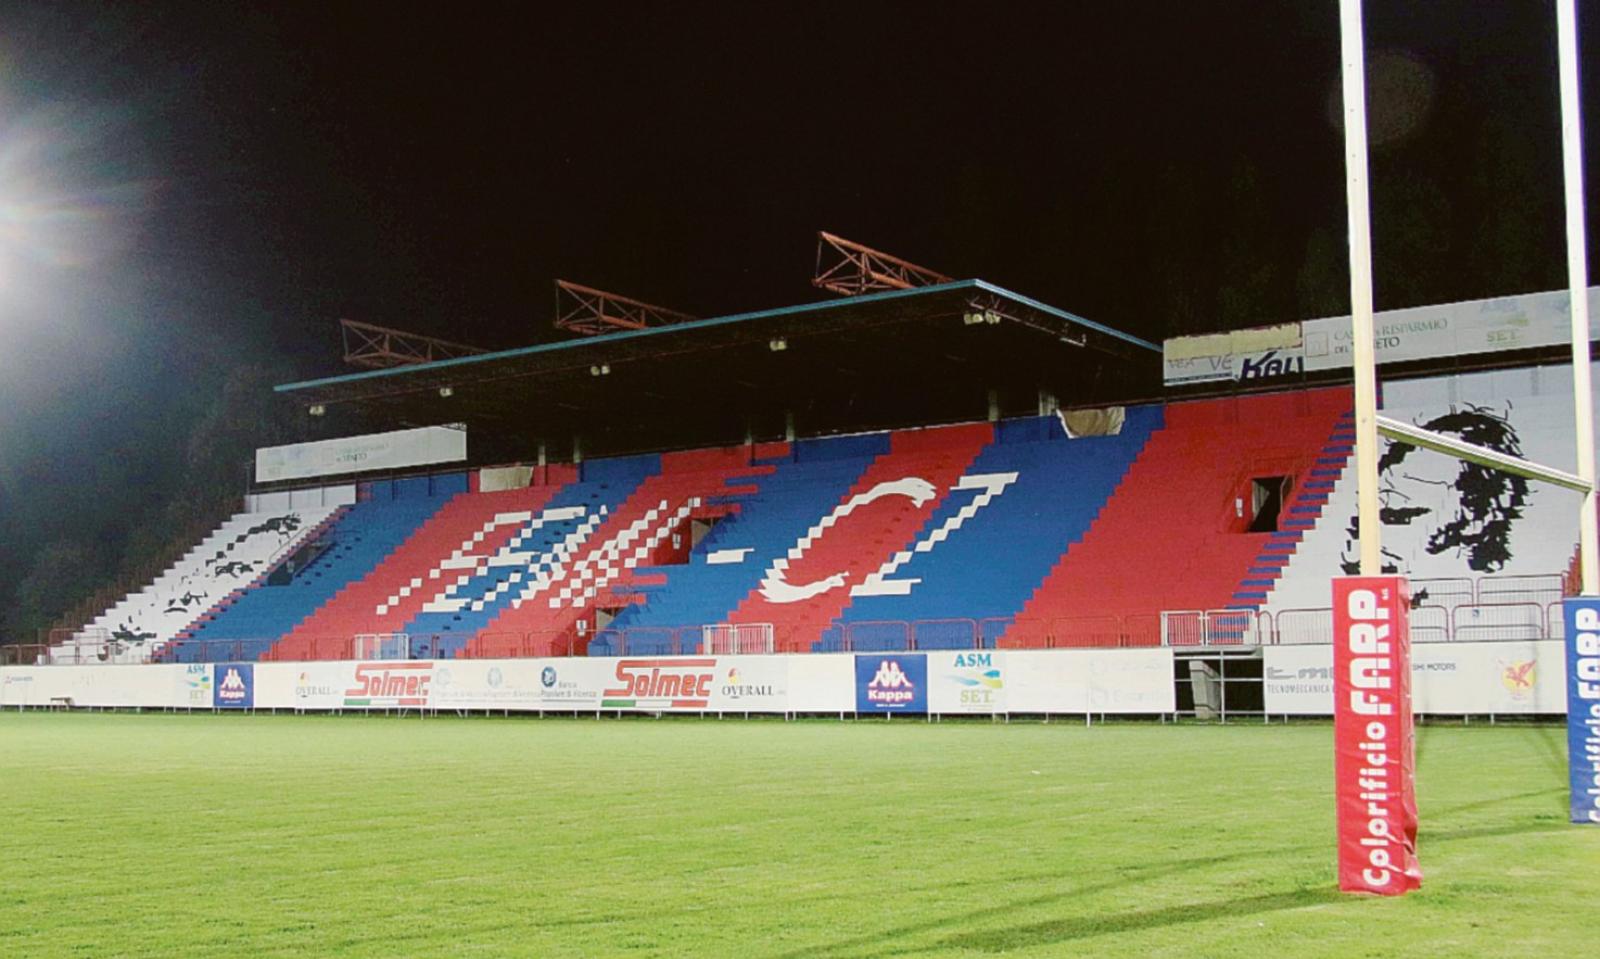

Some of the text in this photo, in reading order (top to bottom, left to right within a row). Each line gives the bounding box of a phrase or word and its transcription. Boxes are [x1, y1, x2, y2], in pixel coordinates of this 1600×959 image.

[953, 654, 992, 668] ASM
[1427, 663, 1456, 671] MOTORS
[343, 661, 434, 697] Solmec
[602, 659, 717, 697] Solmec
[721, 685, 774, 698] OVERALL
[868, 690, 913, 702] Kappa
[1348, 589, 1392, 887] Colorificio FARP
